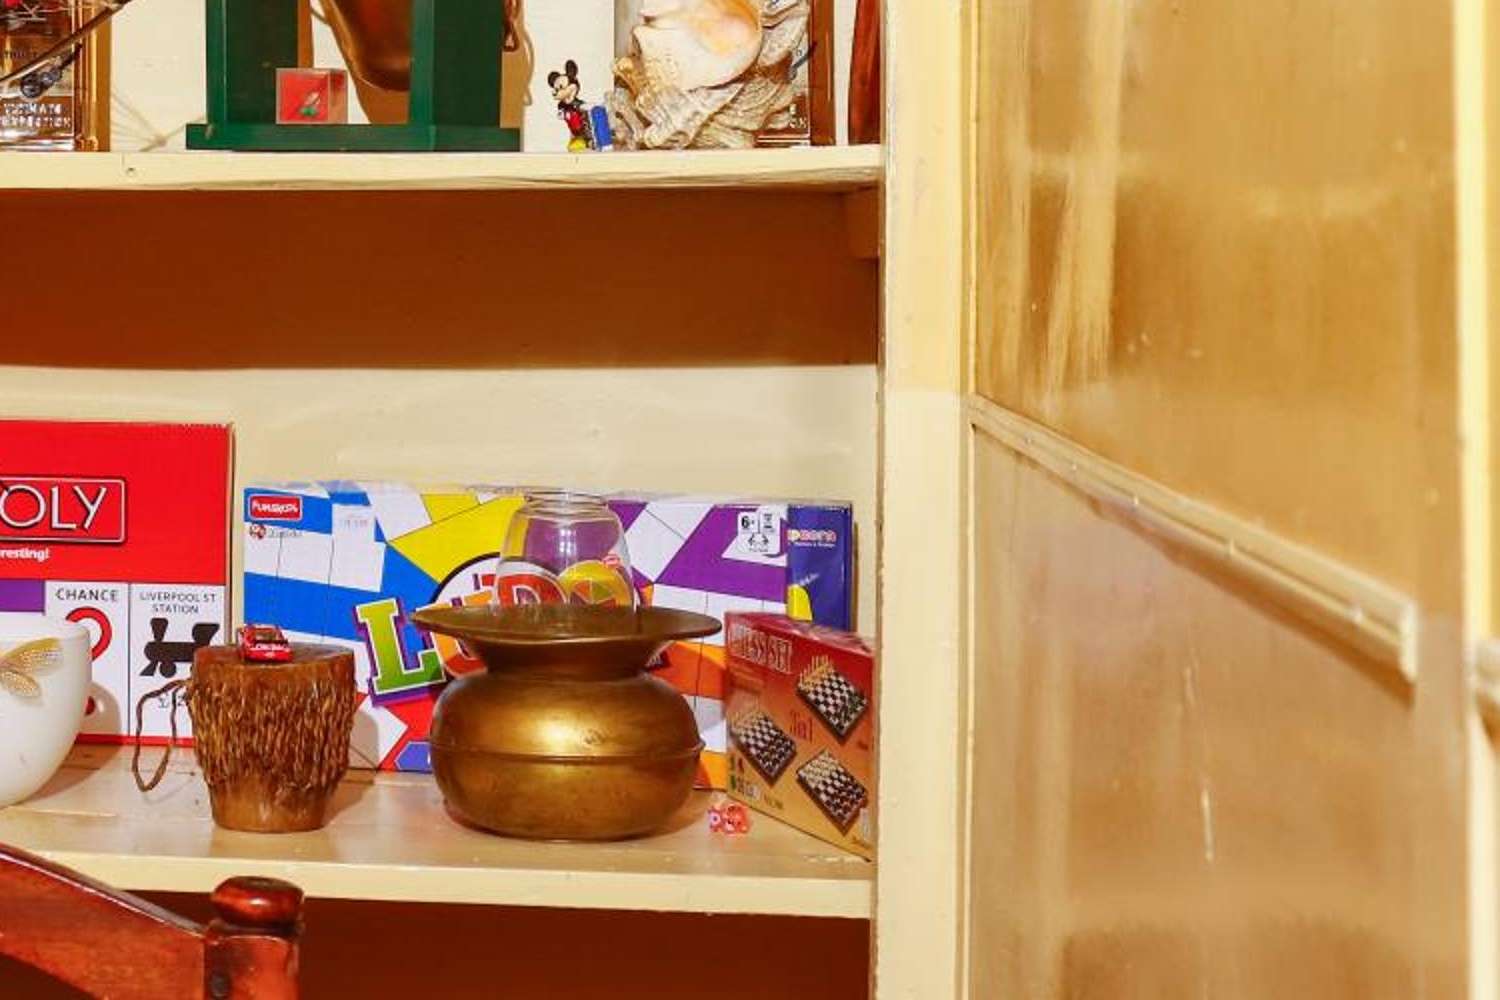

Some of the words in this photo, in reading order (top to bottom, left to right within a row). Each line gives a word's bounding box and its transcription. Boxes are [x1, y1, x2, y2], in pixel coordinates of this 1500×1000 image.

[55, 588, 119, 602] CHANCE
[139, 591, 200, 602] LIVERPOOL
[203, 592, 217, 603] ST
[151, 603, 199, 615] STATION
